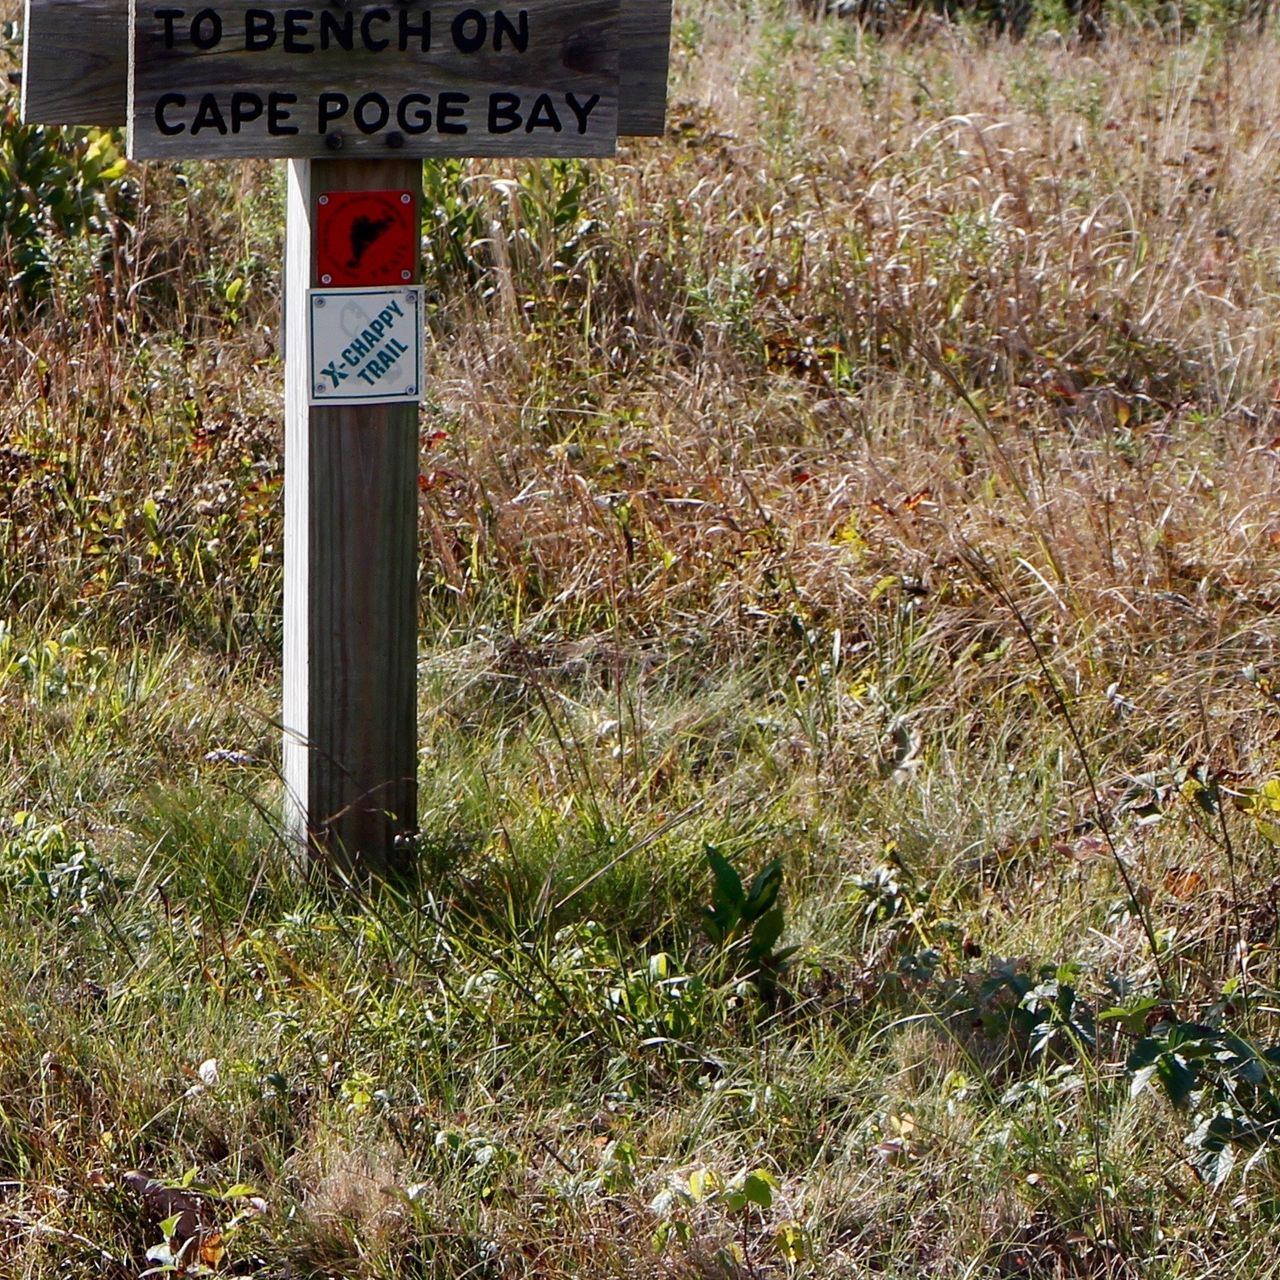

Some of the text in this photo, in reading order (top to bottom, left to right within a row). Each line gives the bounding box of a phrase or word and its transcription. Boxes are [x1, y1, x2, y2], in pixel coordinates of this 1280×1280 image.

[154, 9, 529, 54] TO BENCH ON
[155, 92, 601, 135] CAPE POGE BAY
[321, 300, 404, 389] X-CHAPPY
[357, 338, 409, 386] TRAIL
